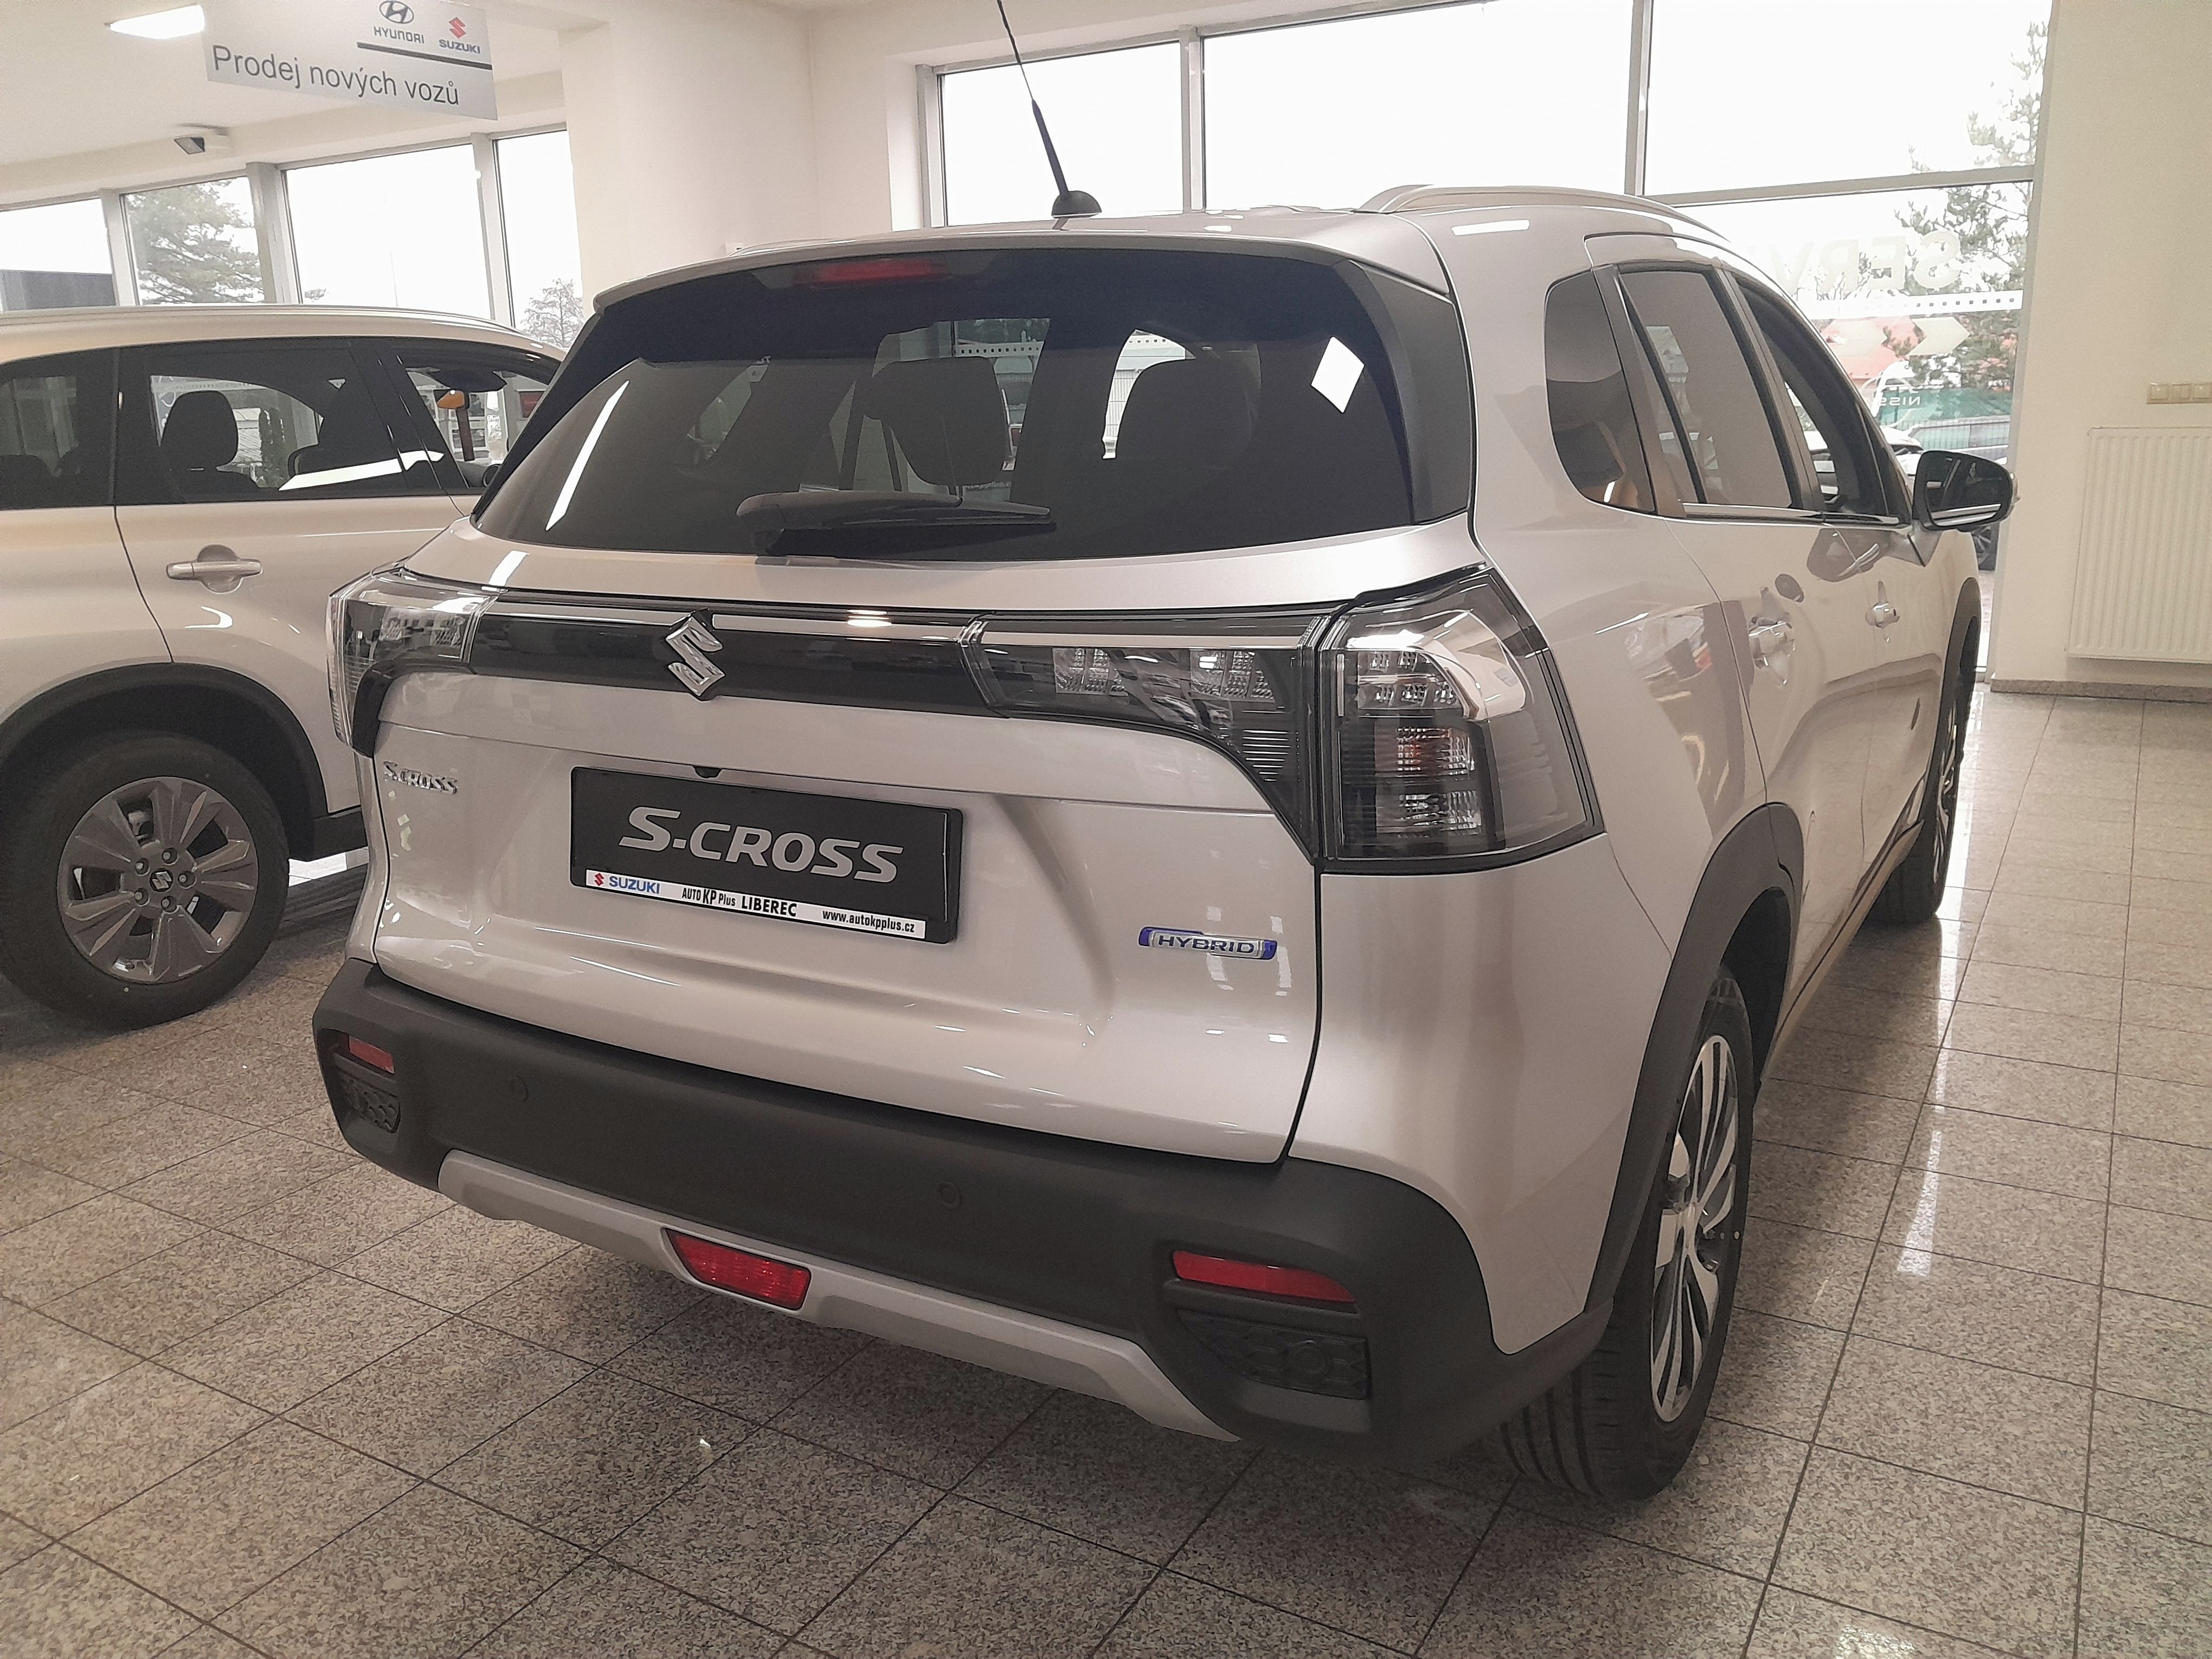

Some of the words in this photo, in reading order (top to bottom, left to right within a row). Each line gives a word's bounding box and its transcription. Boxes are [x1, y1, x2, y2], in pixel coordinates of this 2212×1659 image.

[374, 26, 425, 44] HYUNDAI
[439, 39, 481, 54] SUZUKI
[212, 44, 301, 89] Prodej
[309, 66, 396, 98] nových
[404, 80, 459, 105] vozů
[609, 875, 660, 895] SUZUKI
[681, 888, 702, 901] AUTO
[703, 889, 717, 905] KP
[718, 894, 736, 907] Plus
[741, 896, 797, 917] LIBEREC
[822, 910, 915, 933] www.autokpplus.cz
[1158, 935, 1255, 953] HYBRID
